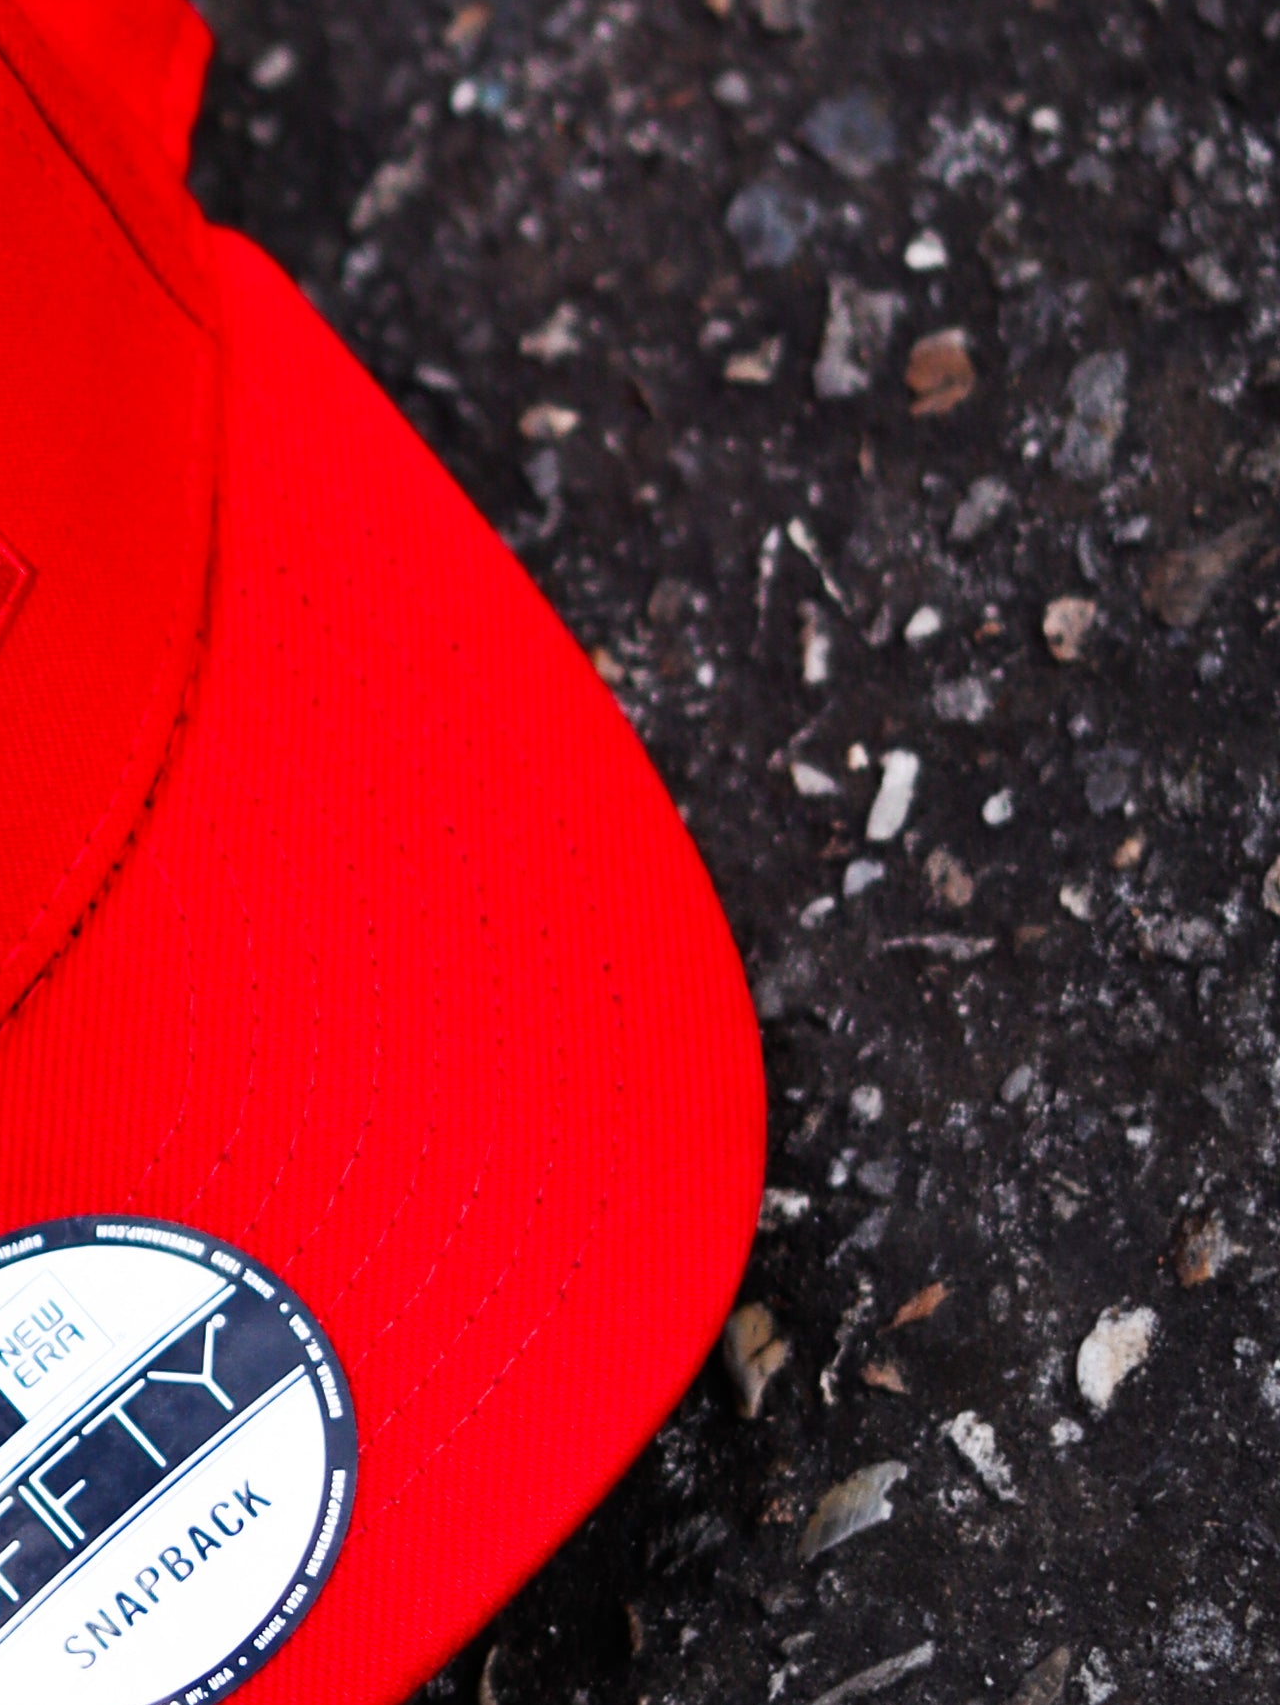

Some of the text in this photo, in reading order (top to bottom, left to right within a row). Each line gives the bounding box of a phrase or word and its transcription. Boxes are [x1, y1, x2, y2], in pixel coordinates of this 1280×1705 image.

[13, 1322, 86, 1388] ERA
[63, 1480, 272, 1669] SNAPBACK
[206, 1666, 235, 1691] USA
